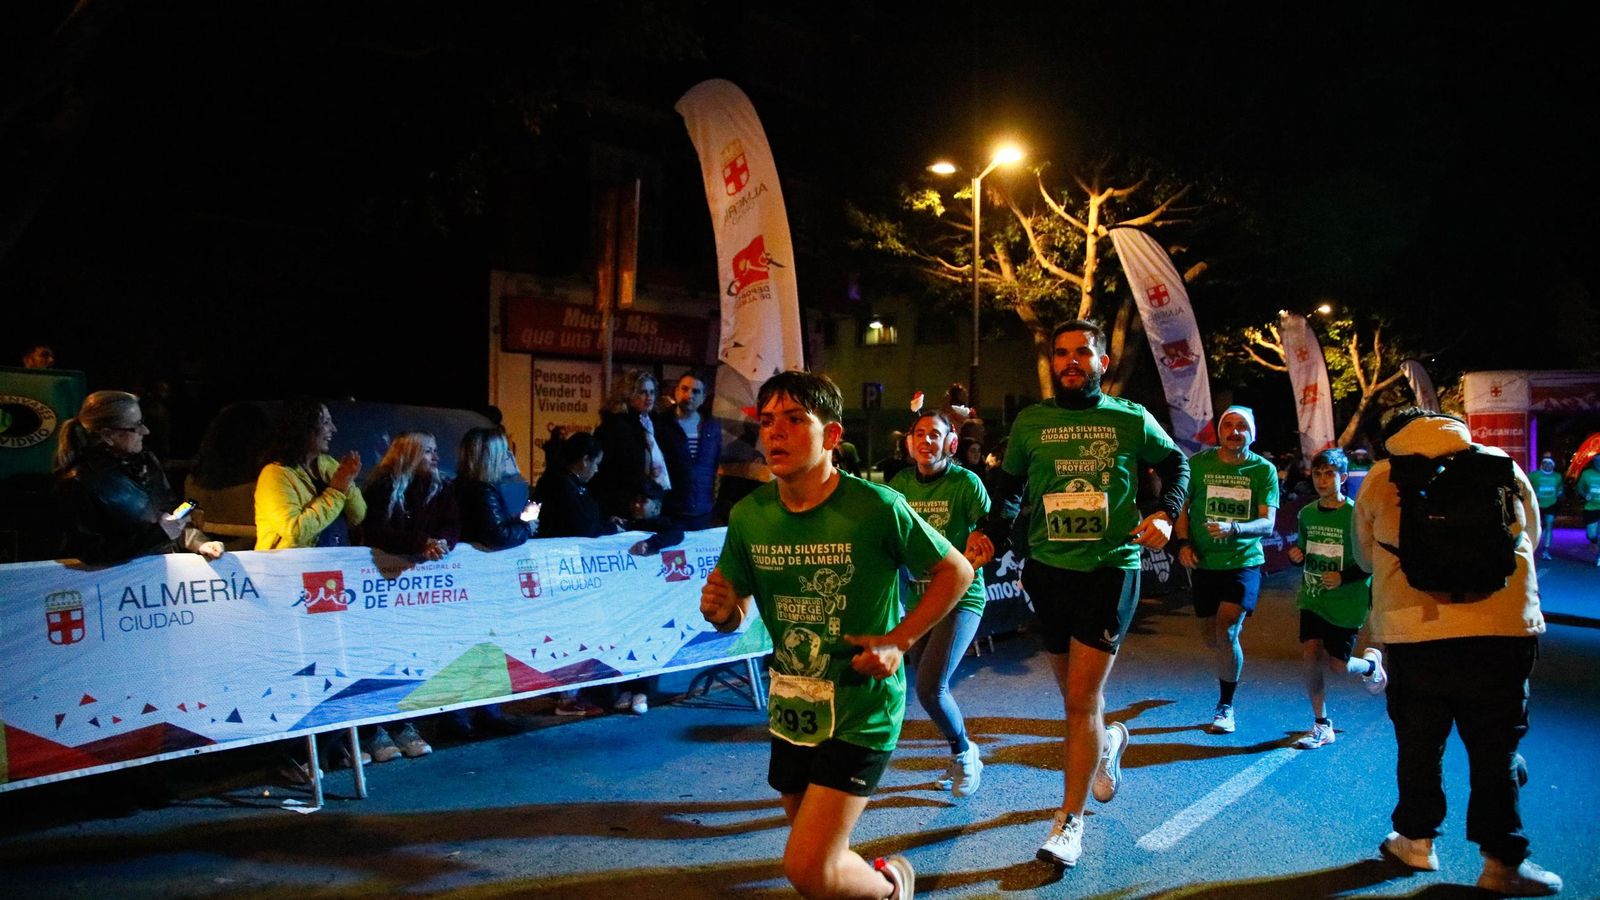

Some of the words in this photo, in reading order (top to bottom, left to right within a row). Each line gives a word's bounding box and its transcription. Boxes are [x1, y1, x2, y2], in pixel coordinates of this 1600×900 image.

[564, 308, 621, 330] Muco
[521, 327, 555, 347] que
[535, 369, 592, 384] Pensando
[535, 383, 576, 398] Vender
[580, 386, 592, 399] tu
[538, 399, 588, 413] Vivienda
[1075, 426, 1116, 434] SILVESTRE
[1083, 432, 1117, 440] ALMERÍA
[1057, 464, 1095, 472] PROTEGE
[1209, 501, 1246, 515] 1059
[1051, 516, 1102, 533] 1123
[751, 544, 768, 555] XVII
[771, 545, 792, 555] SAN
[794, 543, 852, 555] SILVESTRE
[558, 550, 637, 575] ALMERÍA
[752, 555, 785, 565] CIUDAD
[788, 556, 801, 565] DE
[804, 553, 852, 565] ALMERÍA
[363, 574, 454, 593] DEPORTES
[559, 577, 602, 592] CIUDAD
[118, 572, 260, 611] ALMERÍA
[365, 594, 388, 609] DE
[394, 588, 469, 607] ALMERIA
[777, 602, 822, 615] PROTEGE
[119, 610, 194, 632] CIUDAD
